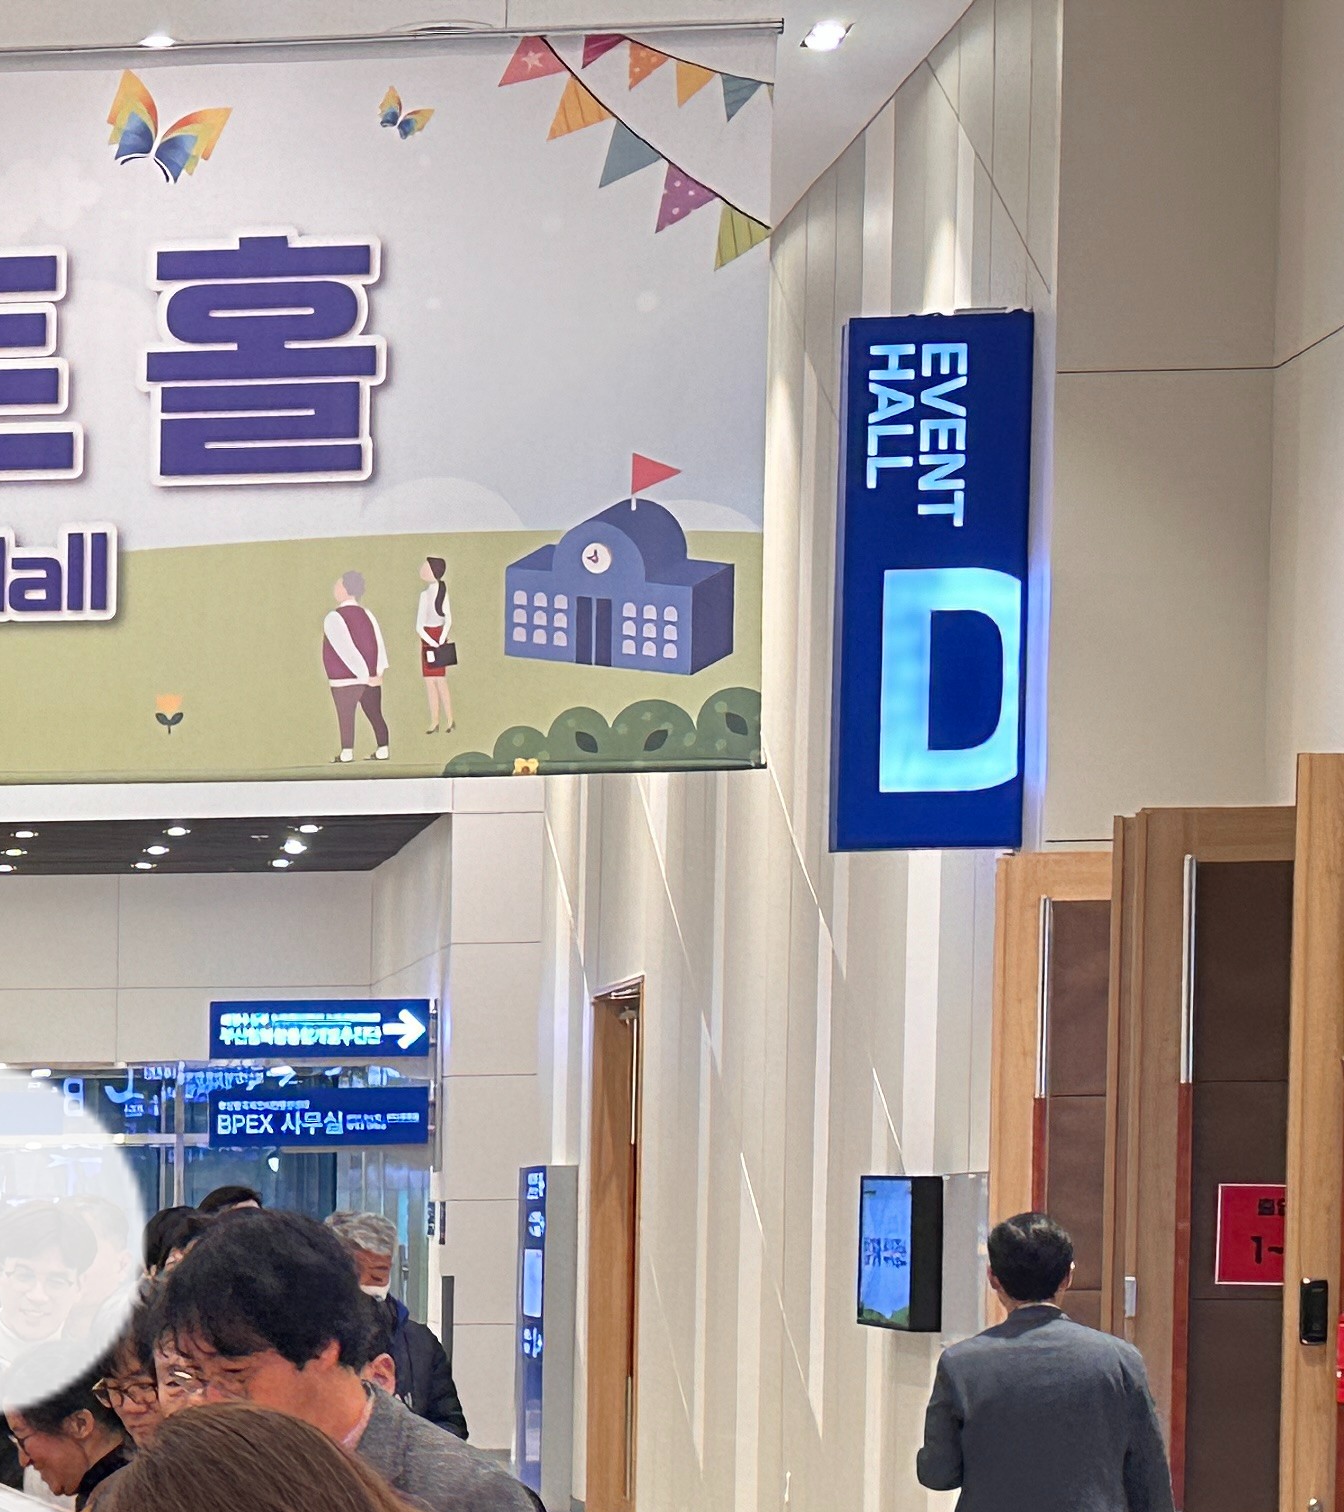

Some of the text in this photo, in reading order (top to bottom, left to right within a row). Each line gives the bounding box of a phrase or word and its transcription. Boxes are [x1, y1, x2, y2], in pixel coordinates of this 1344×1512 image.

[146, 235, 380, 480] 홀
[866, 343, 916, 489] HALL
[918, 342, 968, 527] EVENT
[879, 567, 1021, 793] D
[217, 1113, 274, 1135] BPEX
[281, 1110, 344, 1136] 사무실
